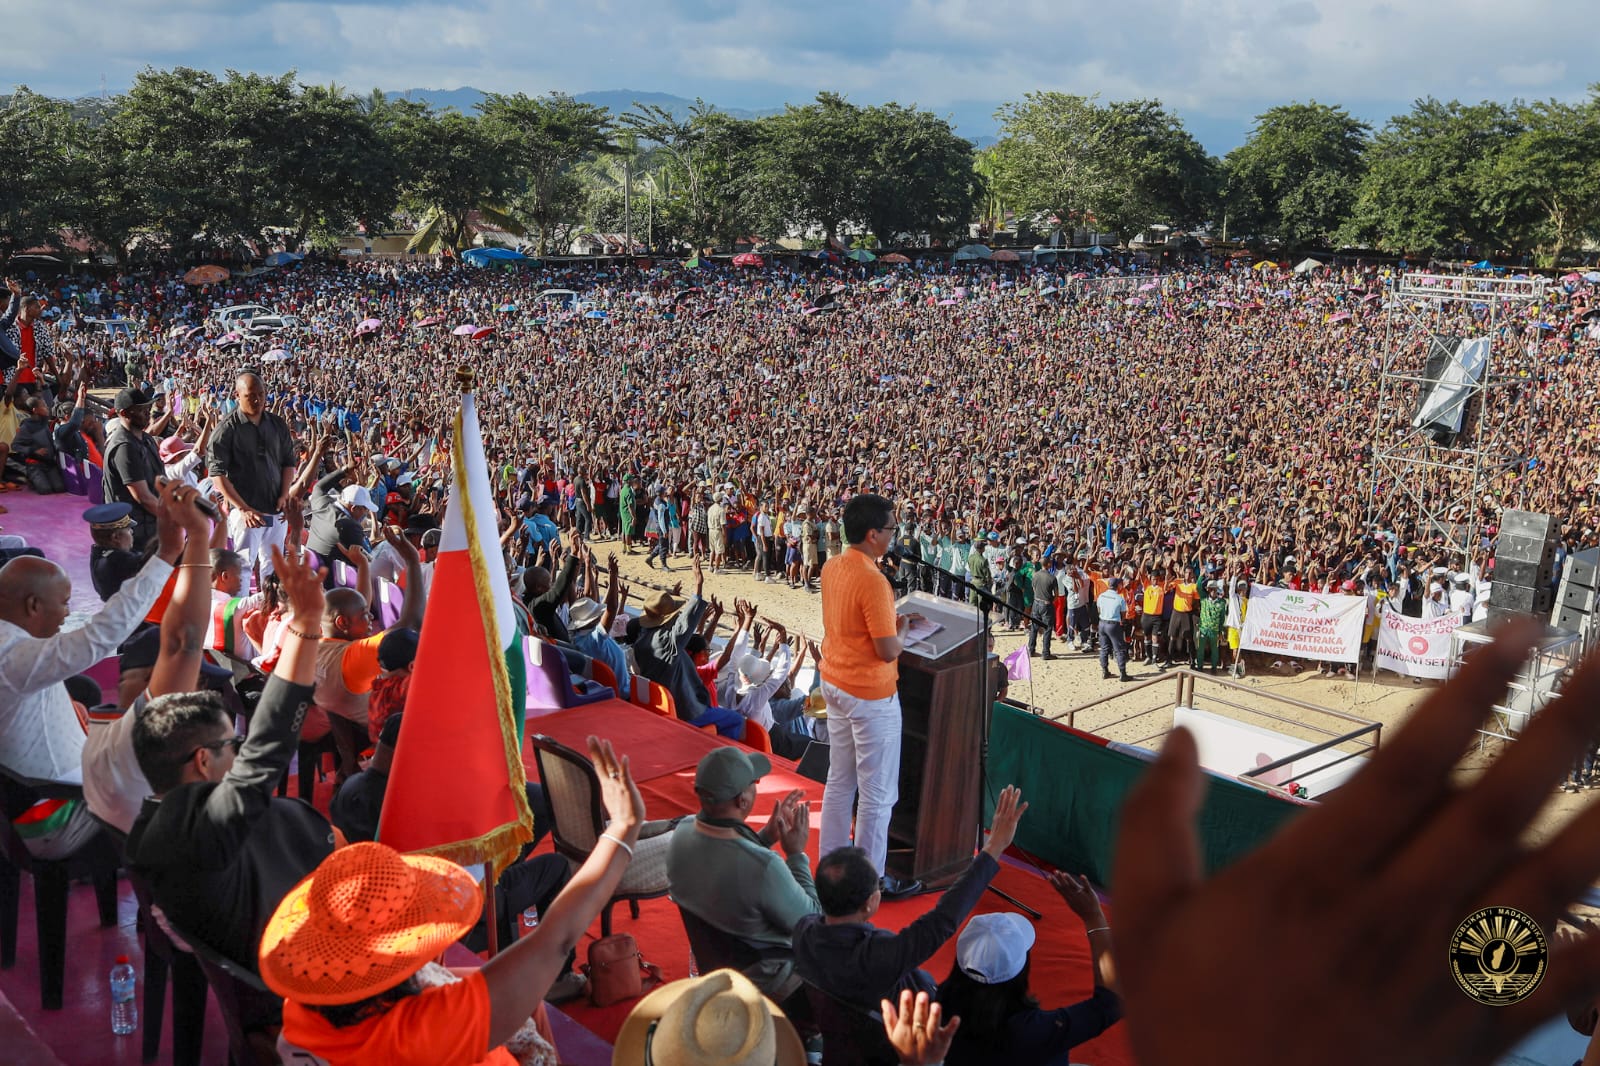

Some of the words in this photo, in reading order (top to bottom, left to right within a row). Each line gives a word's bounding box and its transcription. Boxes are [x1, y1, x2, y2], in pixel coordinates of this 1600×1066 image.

[1286, 594, 1304, 604] MJS
[1270, 621, 1335, 635] AMBATOSOA
[1260, 629, 1343, 645] MANKASITRAKA
[1252, 637, 1289, 650] ANDRE
[1293, 643, 1347, 655] MAMANGY
